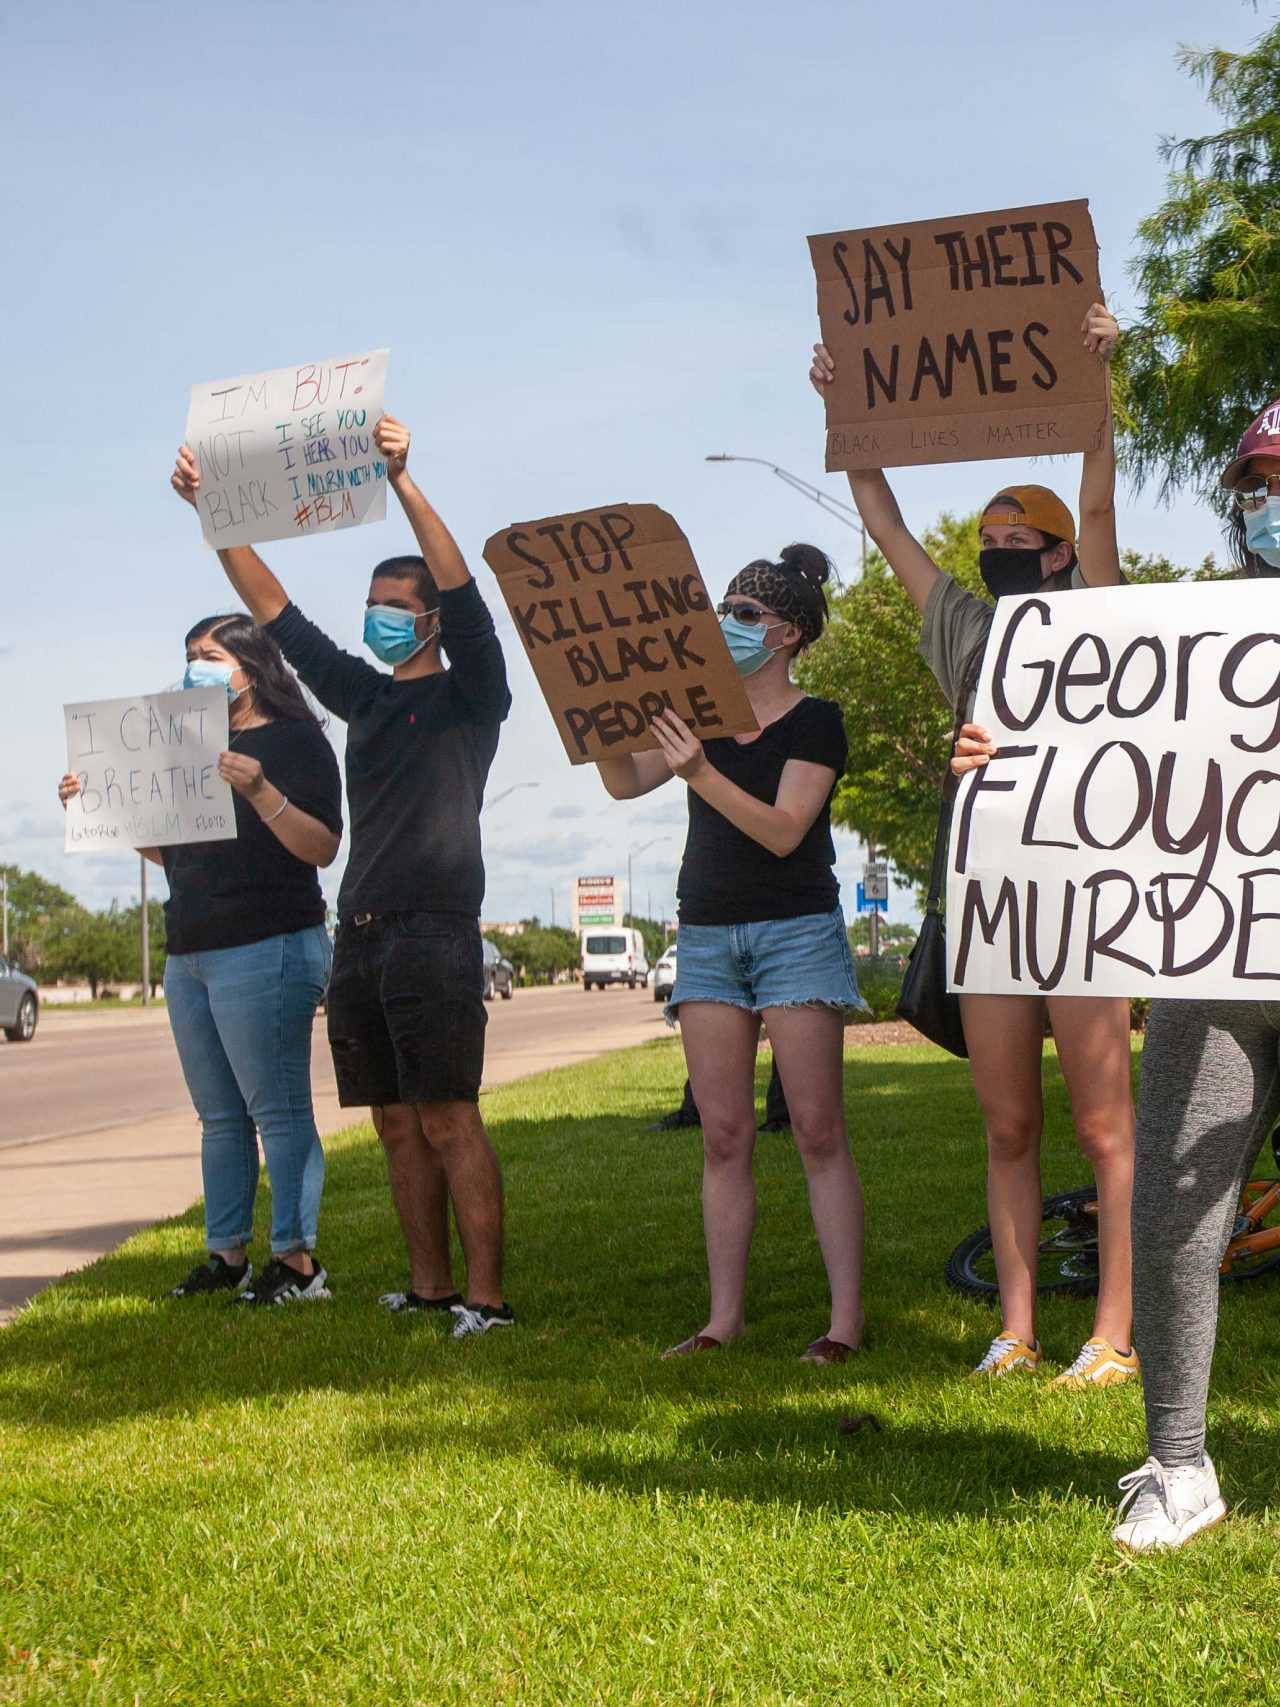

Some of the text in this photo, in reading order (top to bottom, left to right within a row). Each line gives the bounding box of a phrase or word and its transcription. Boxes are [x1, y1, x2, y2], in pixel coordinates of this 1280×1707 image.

[832, 221, 1084, 326] SAY THEIR
[863, 321, 1058, 410] NAMES
[275, 409, 367, 445] I SEE YOU
[277, 435, 370, 471] I HEAR YOU
[830, 421, 1064, 456] BLACK LIVES MATTER
[199, 429, 256, 482] NOT
[204, 478, 280, 533] BLACK
[288, 476, 303, 501] I
[294, 491, 357, 531] #BLM
[506, 512, 635, 589] STOP
[512, 573, 709, 649] KILLING
[564, 624, 706, 688] BLACK
[119, 704, 209, 752] CAN'T
[563, 684, 724, 756] PEOPLE
[77, 763, 217, 814] BREATHE
